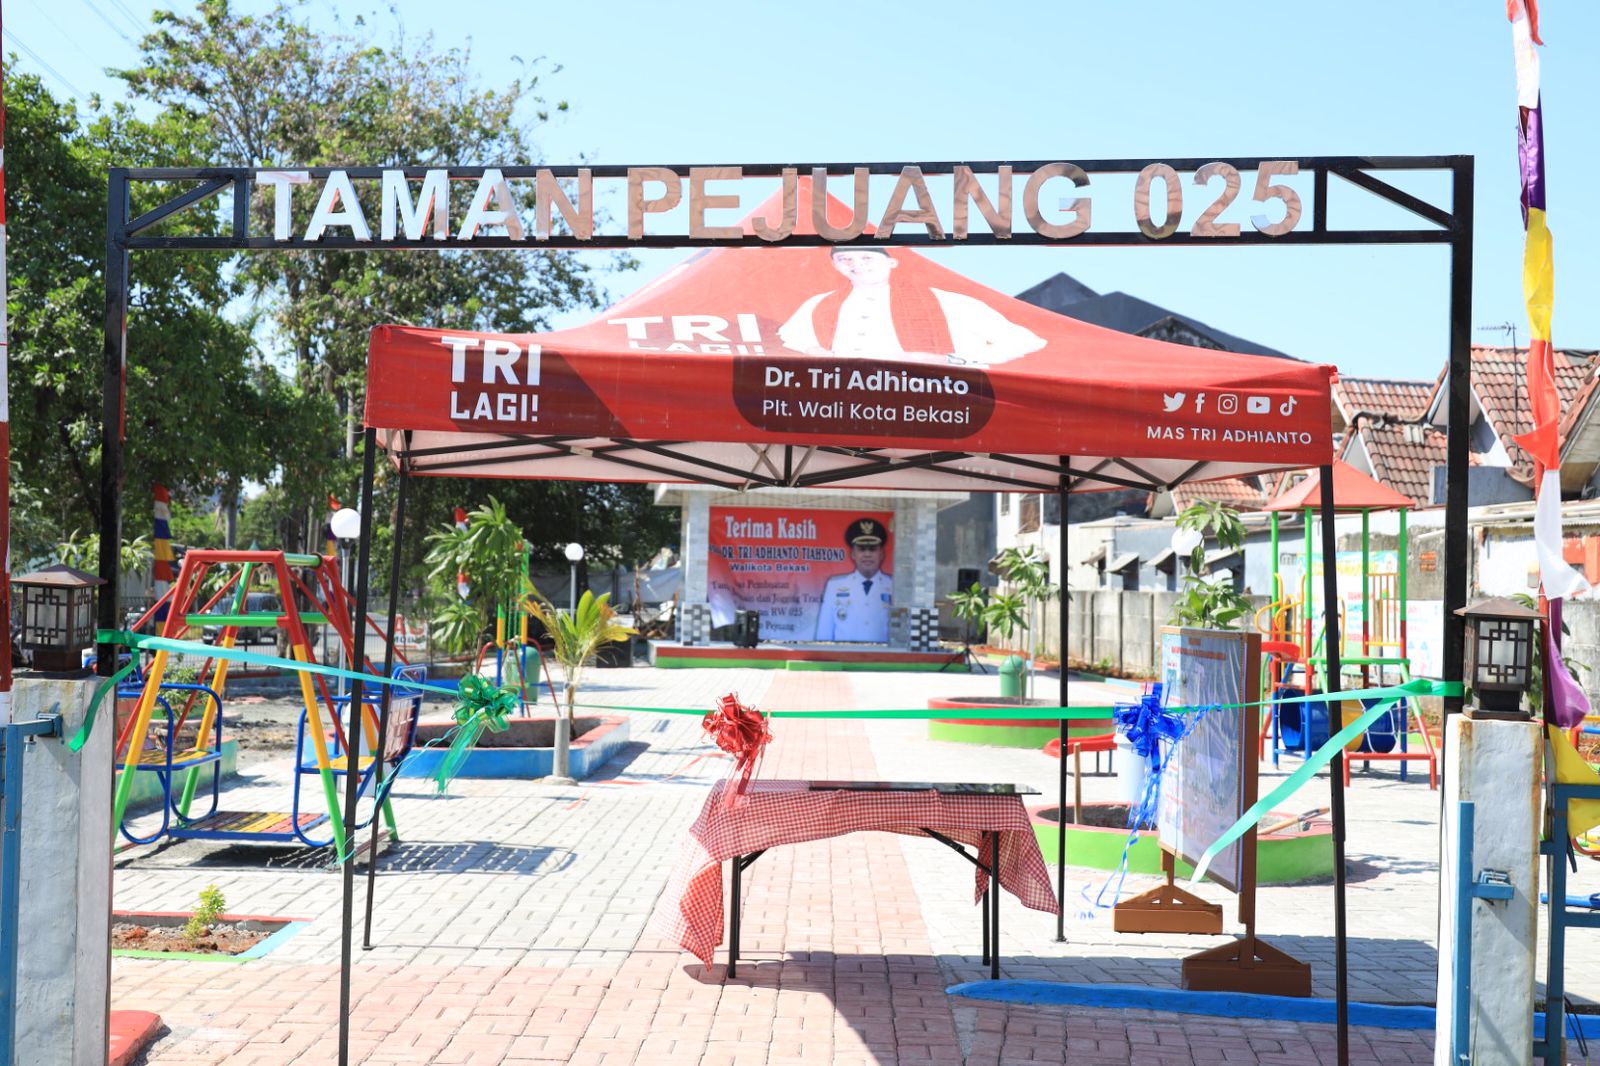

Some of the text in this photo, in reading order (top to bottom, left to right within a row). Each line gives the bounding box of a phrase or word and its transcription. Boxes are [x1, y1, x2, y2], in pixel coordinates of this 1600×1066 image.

[256, 160, 1302, 242] TAMAN PEJUANG 025
[607, 313, 762, 343] TRI
[441, 335, 542, 387] TRI
[764, 366, 969, 396] Dr. Tri Adhianto
[450, 391, 539, 423] LAGI!
[762, 399, 970, 425] Plt. Wali Kota Bekasi
[1147, 426, 1313, 445] MAS TRI ADHIANTO
[725, 515, 817, 540] Terima Kasih
[737, 545, 753, 560] TRI
[755, 546, 799, 561] ADHIANTO
[729, 562, 811, 573] Walikota Bekasi
[771, 607, 788, 617] RW
